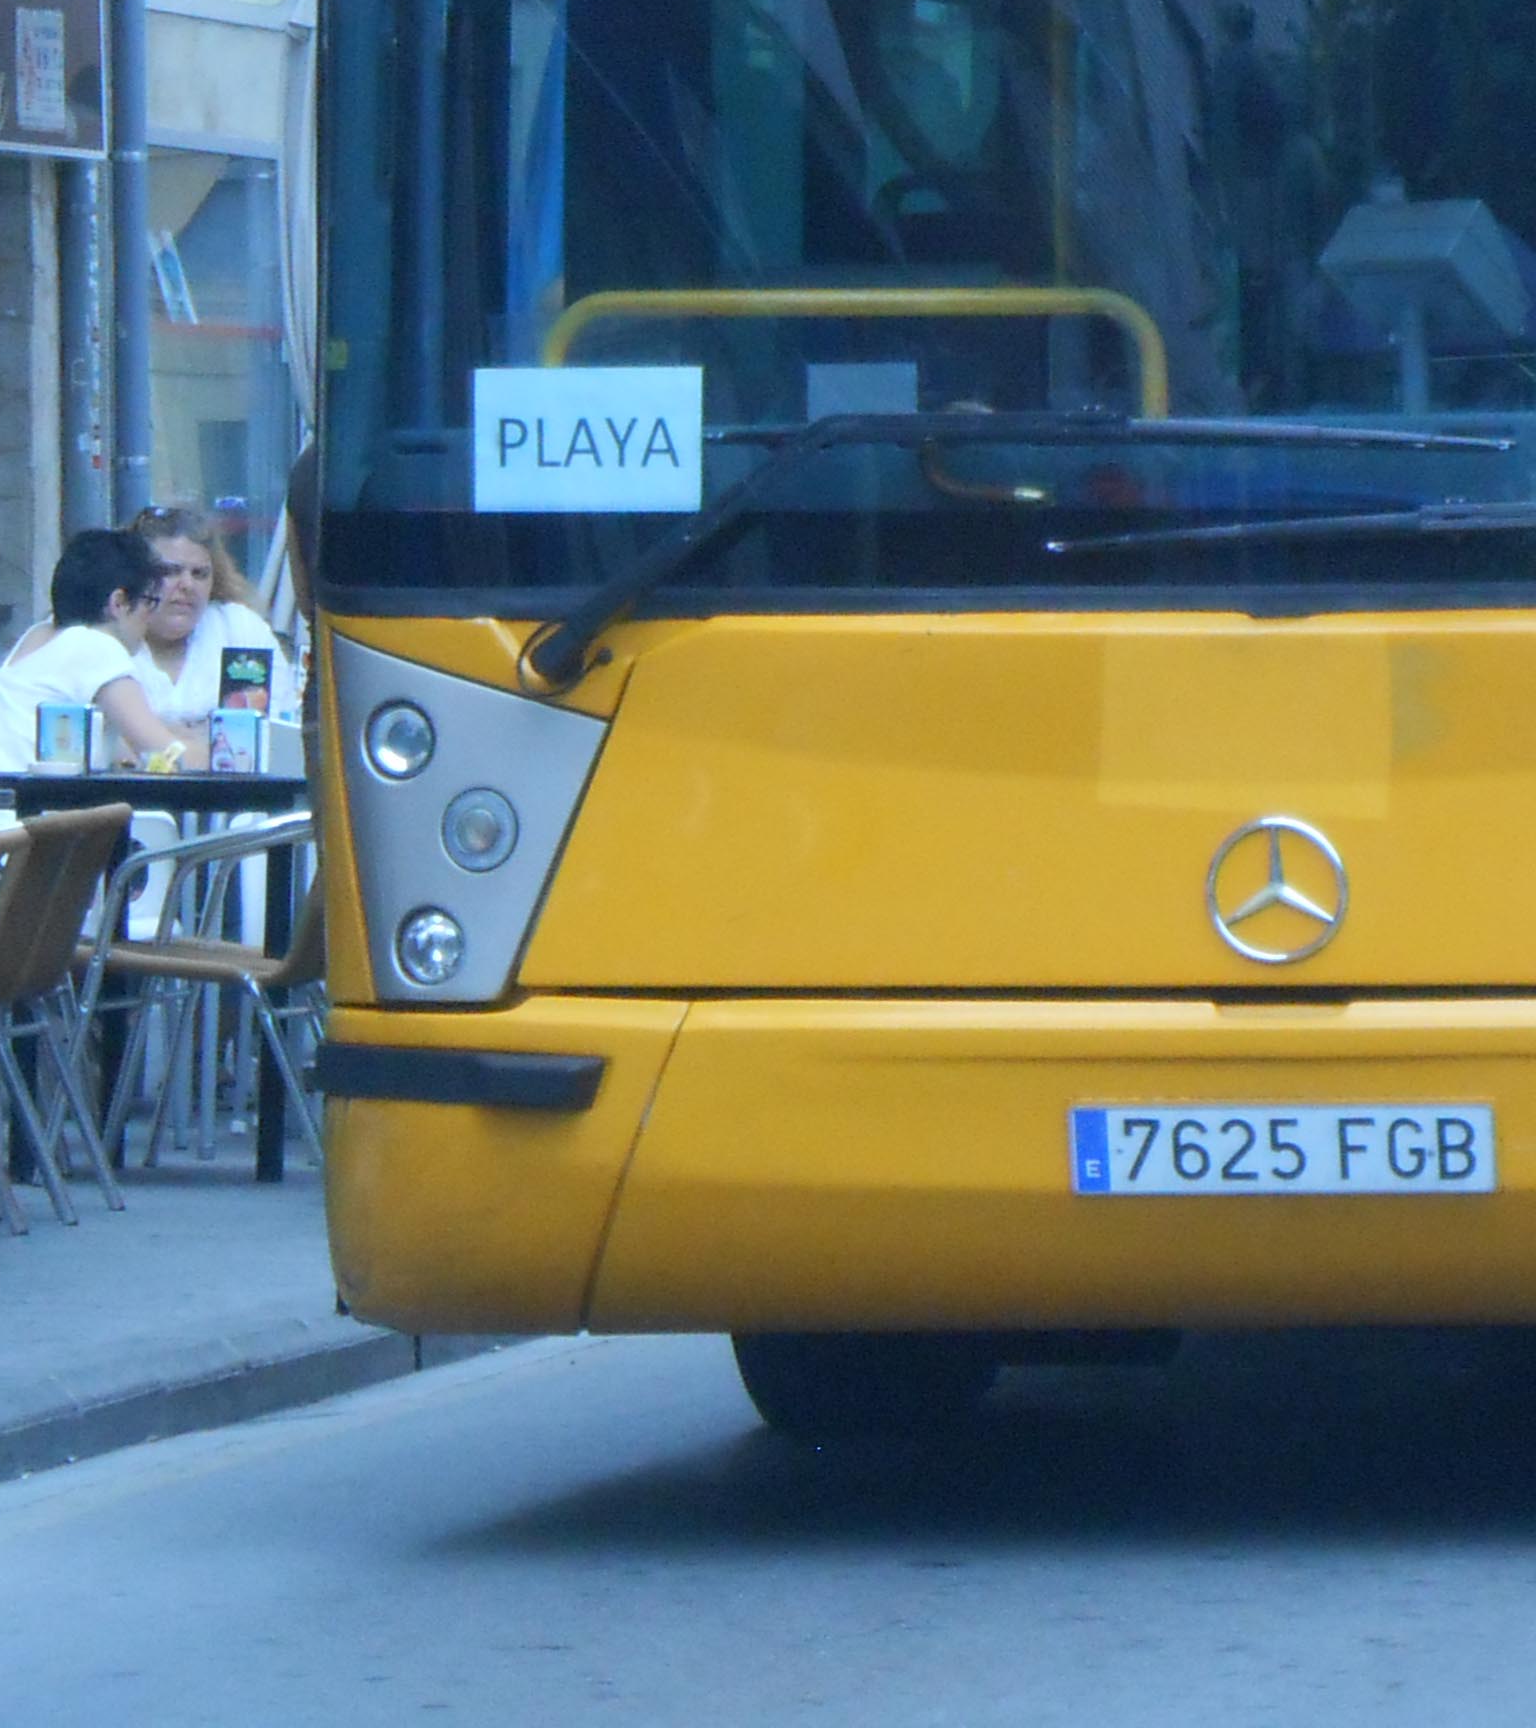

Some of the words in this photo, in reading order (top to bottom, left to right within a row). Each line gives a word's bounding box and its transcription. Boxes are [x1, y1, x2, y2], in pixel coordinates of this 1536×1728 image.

[498, 416, 680, 468] PLAYA
[1085, 1159, 1102, 1178] E
[1122, 1118, 1307, 1181] 7625
[1337, 1117, 1477, 1181] FGB
